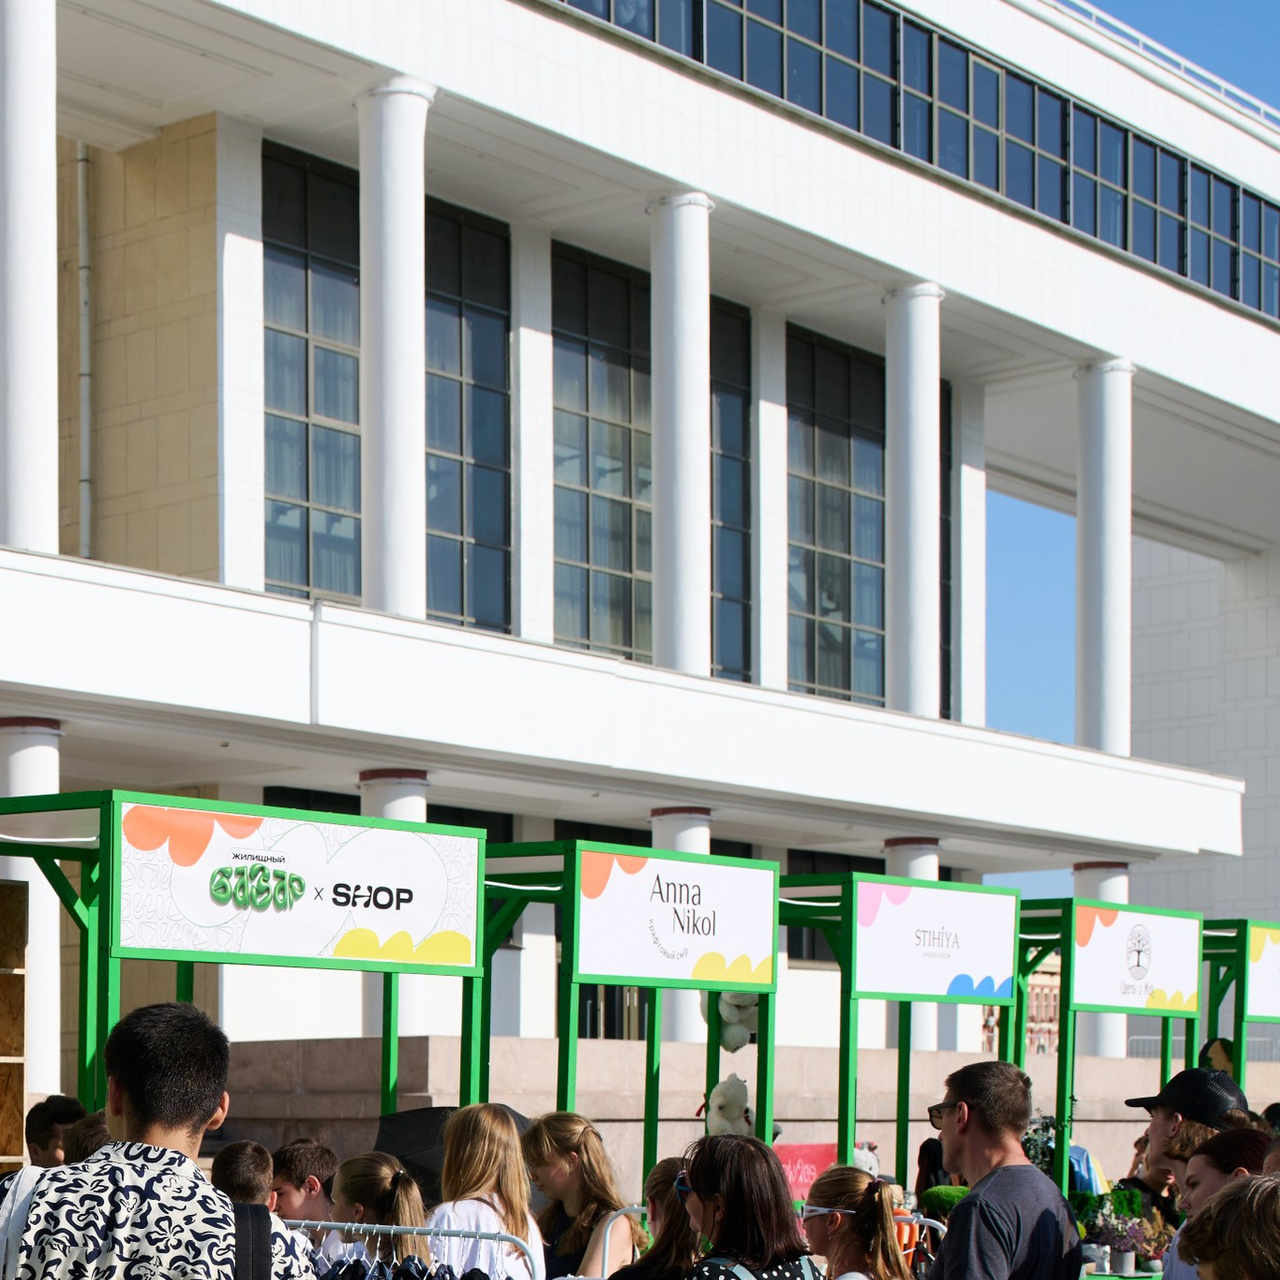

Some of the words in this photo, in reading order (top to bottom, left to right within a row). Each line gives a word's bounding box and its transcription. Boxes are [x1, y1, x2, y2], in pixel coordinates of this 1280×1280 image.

[332, 883, 414, 911] SHOP
[650, 874, 701, 906] Anna
[672, 906, 716, 936] Nikol
